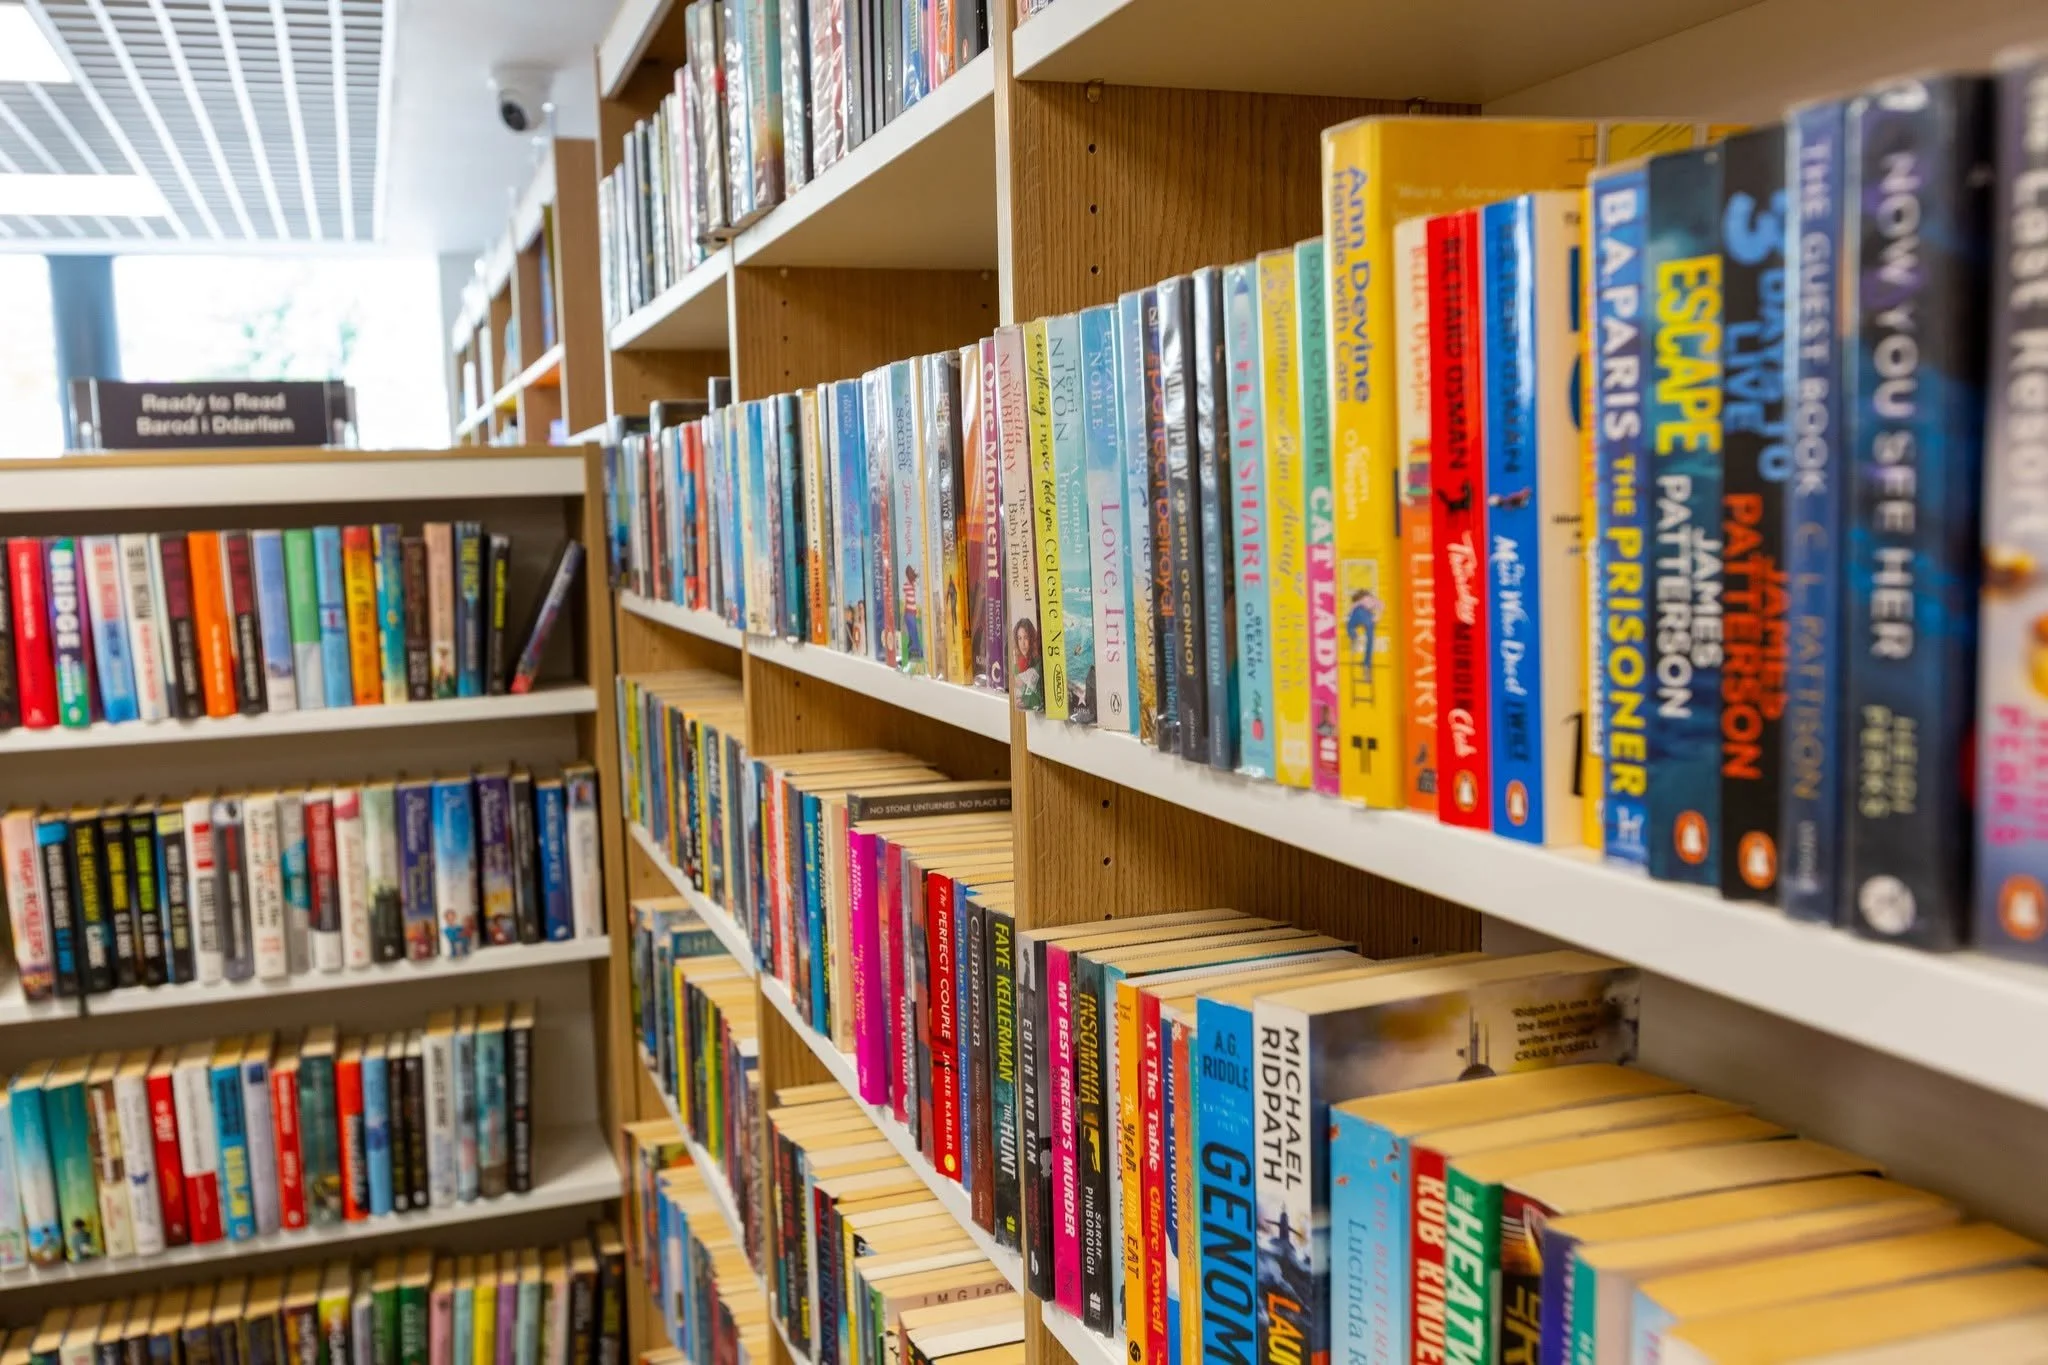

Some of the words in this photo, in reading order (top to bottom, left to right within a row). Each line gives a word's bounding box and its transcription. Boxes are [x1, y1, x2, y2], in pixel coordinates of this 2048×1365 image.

[1347, 166, 1368, 250] Ann
[1800, 136, 1830, 220] THE
[1332, 169, 1351, 266] Handle
[1724, 189, 1785, 266] 3
[1878, 150, 1924, 288] NOW
[1308, 254, 1323, 345] DAWN
[1335, 273, 1352, 333] with
[1441, 236, 1465, 358] RICHARD
[1497, 222, 1521, 353] RICHARD
[1797, 231, 1831, 364] GUEST
[1271, 300, 1291, 403] Summer
[1350, 261, 1374, 404] Devine
[1601, 287, 1642, 442] PARIS
[1654, 253, 1723, 456] ESCAPE
[1758, 266, 1791, 405] DAYS
[1871, 305, 1921, 419] YOU
[141, 393, 206, 414] Ready
[209, 394, 230, 412] to
[233, 392, 286, 412] Read
[983, 362, 996, 433] One
[1030, 334, 1050, 417] everything
[1050, 337, 1068, 442] NIXON
[1065, 360, 1077, 413] Terri
[1088, 351, 1103, 430] NOBLE
[1104, 331, 1116, 446] ELIZABETH
[1336, 340, 1354, 403] Care
[1723, 321, 1763, 436] LIVE
[136, 416, 197, 436] Barod
[201, 418, 209, 434] i
[212, 416, 295, 434] Ddarllen
[896, 407, 906, 470] secret
[999, 353, 1016, 474] NEWBERRY
[1013, 380, 1024, 445] Sheila
[1147, 368, 1169, 491] perfect
[1312, 351, 1331, 476] O'PORTER
[1447, 365, 1469, 471] OSMAN
[1499, 360, 1522, 474] OSMAN
[1758, 414, 1791, 483] TO
[1794, 376, 1829, 496] BOOK
[1041, 433, 1050, 471] never
[1274, 435, 1296, 482] Ran
[1611, 453, 1637, 517] THE
[1872, 429, 1916, 535] SEE
[984, 440, 1000, 580] Moment
[1008, 503, 1019, 537] Baby
[1018, 486, 1027, 515] The
[1038, 508, 1054, 532] you
[1042, 479, 1056, 504] told
[1060, 472, 1070, 544] Promise
[1071, 486, 1083, 554] Cornish
[1176, 488, 1189, 561] JOSEPH
[1310, 485, 1335, 569] CAT
[873, 533, 882, 600] Murders
[1011, 543, 1020, 588] Home
[1021, 520, 1030, 573] Mother
[1100, 504, 1120, 594] Love,
[1154, 498, 1175, 617] betrayal
[1206, 543, 1217, 596] GLASS
[1277, 491, 1301, 576] Away
[50, 549, 80, 649] BRIDGE
[1023, 576, 1032, 601] and
[1045, 539, 1059, 619] Celeste
[1446, 531, 1480, 626] Thursday
[1498, 590, 1530, 638] Who
[1656, 474, 1692, 718] PATTERSON
[1691, 527, 1724, 668] JAMES
[1869, 547, 1915, 660] HER
[1048, 630, 1062, 657] Ng
[1105, 606, 1125, 663] Iris
[1164, 632, 1177, 683] Lauren
[1179, 569, 1195, 677] O'CONNOR
[1209, 604, 1221, 686] KINGDOM
[1244, 602, 1256, 680] O'LEARY
[1254, 615, 1263, 665] BETH
[1278, 604, 1291, 692] OLIVER
[1293, 613, 1306, 689] JENNY
[1313, 580, 1338, 695] LADY
[1410, 553, 1438, 730] LIBRARY
[1607, 526, 1646, 797] PRISONER
[1721, 492, 1762, 780] PATTERSON
[1759, 556, 1790, 720] JAMES
[1055, 669, 1063, 702] ABACUS
[1166, 686, 1179, 727] North
[1791, 615, 1826, 800] PATTISON
[1447, 708, 1478, 758] Club
[1857, 704, 1890, 819] PERKS
[1892, 716, 1917, 815] HEIDI
[886, 805, 910, 814] STONE
[974, 800, 997, 808] PLACE
[939, 885, 947, 907] The
[938, 910, 949, 973] PERFECT
[994, 922, 1011, 970] FAYE
[940, 978, 950, 1039] COUPLE
[958, 990, 967, 1048] visiting
[969, 916, 982, 1046] Chinaman
[1057, 980, 1068, 1015] MY
[996, 975, 1014, 1083] KELLERMAN
[1023, 1018, 1033, 1075] EDITH
[1059, 1017, 1070, 1062] BEST
[1079, 992, 1099, 1105] INSOMNIA
[1146, 1024, 1158, 1051] At
[1514, 1047, 1550, 1061] CRAIG
[1552, 1039, 1600, 1056] RUSSELL
[941, 1051, 952, 1097] JACKIE
[1025, 1083, 1035, 1123] AND
[1060, 1066, 1072, 1150] FRIEND'S
[1147, 1056, 1159, 1100] The
[1203, 1055, 1249, 1092] RIDDLE
[1261, 1025, 1282, 1184] RIDPATH
[1284, 1026, 1302, 1191] MICHAEL
[944, 1100, 953, 1151] KABLER
[999, 1121, 1016, 1180] HUNT
[1003, 1104, 1012, 1123] THE
[1025, 1129, 1037, 1165] KIM
[1123, 1122, 1137, 1173] YEAR
[1148, 1109, 1160, 1171] Table
[1061, 1155, 1075, 1238] MURDER
[1085, 1186, 1095, 1276] PINBOROUGH
[1148, 1186, 1162, 1251] Claire
[1416, 1175, 1445, 1245] ROB
[1127, 1235, 1140, 1280] EAT
[1202, 1144, 1252, 1365] GENOM
[1346, 1219, 1369, 1338] Lucinda
[956, 1289, 968, 1300] G
[1151, 1258, 1163, 1335] Powell
